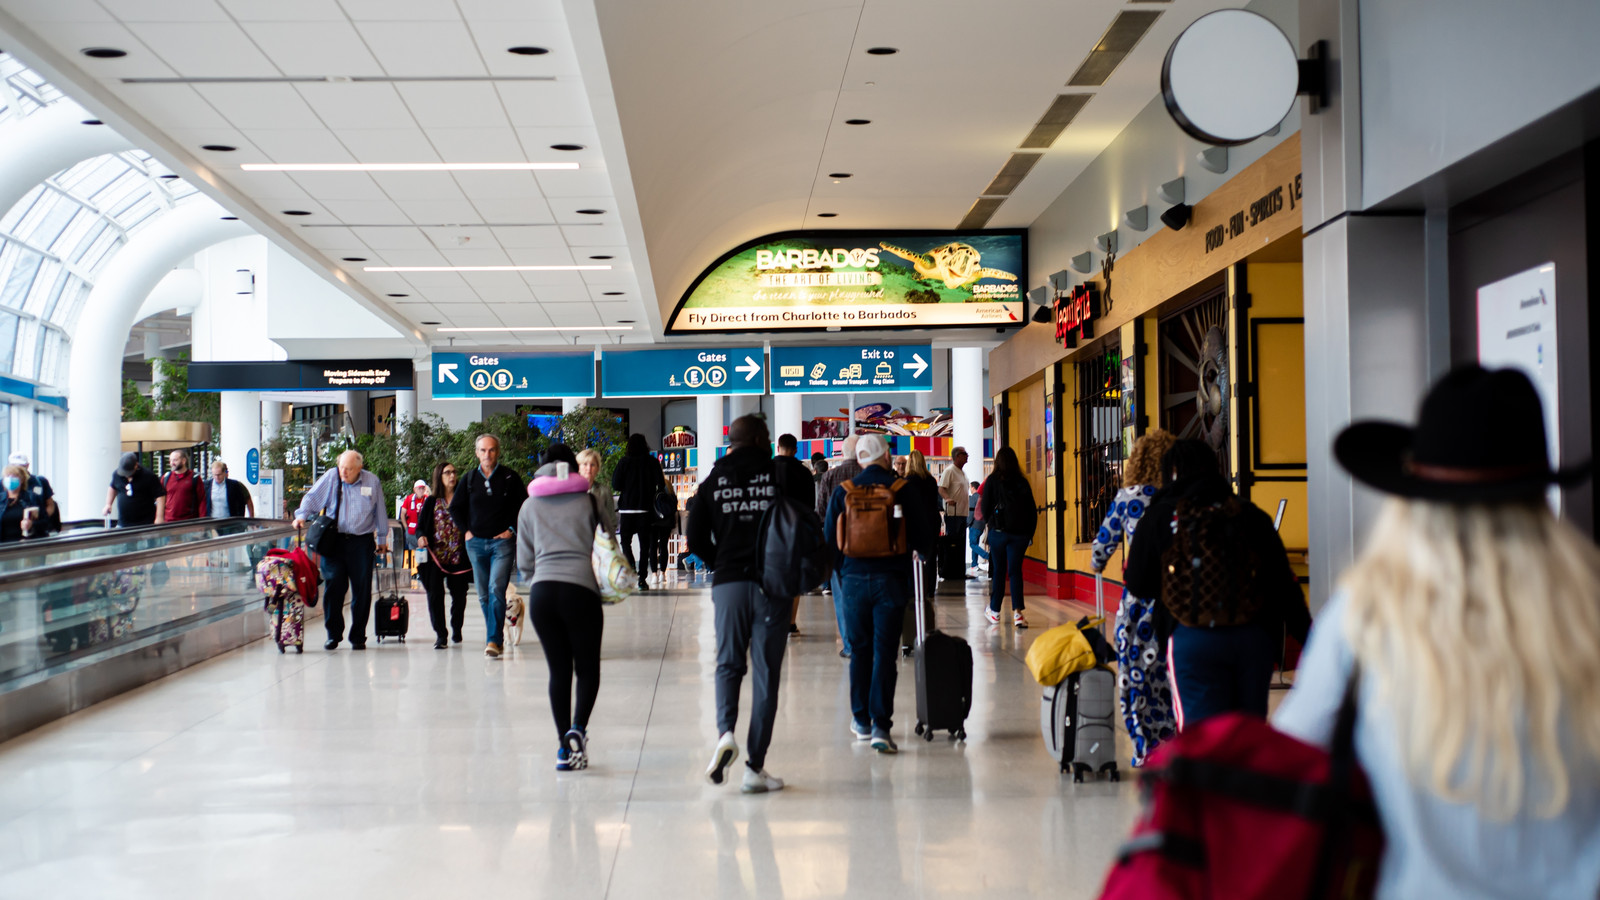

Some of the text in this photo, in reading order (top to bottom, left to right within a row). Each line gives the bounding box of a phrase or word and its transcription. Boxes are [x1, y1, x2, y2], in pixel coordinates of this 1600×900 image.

[1205, 223, 1224, 254] FOOD
[1229, 210, 1244, 240] FUN
[1249, 185, 1283, 227] SPIRITS
[756, 247, 881, 270] BARBADOS
[769, 273, 873, 286] THE ART OF LIVING
[808, 291, 827, 302] your
[829, 287, 885, 303] playground
[973, 284, 1018, 294] BARBADOS
[689, 308, 918, 326] Fly Direct from Charlotte to Barbados
[469, 355, 499, 366] Gates
[697, 351, 727, 363] Gates
[861, 349, 895, 360] Exit to
[347, 369, 374, 377] Sidewalk
[475, 373, 507, 385] A B
[690, 369, 722, 381] E D
[328, 377, 353, 386] Prepare
[360, 376, 374, 385] Step
[375, 376, 386, 384] Off
[784, 379, 801, 387] Lounge
[808, 379, 828, 387] Ticketing
[832, 378, 848, 386] Ground
[849, 378, 869, 386] Transport
[872, 378, 882, 386] Bag
[663, 432, 677, 448] PAPA
[713, 485, 775, 502] FOR THE
[722, 499, 769, 514] STARS
